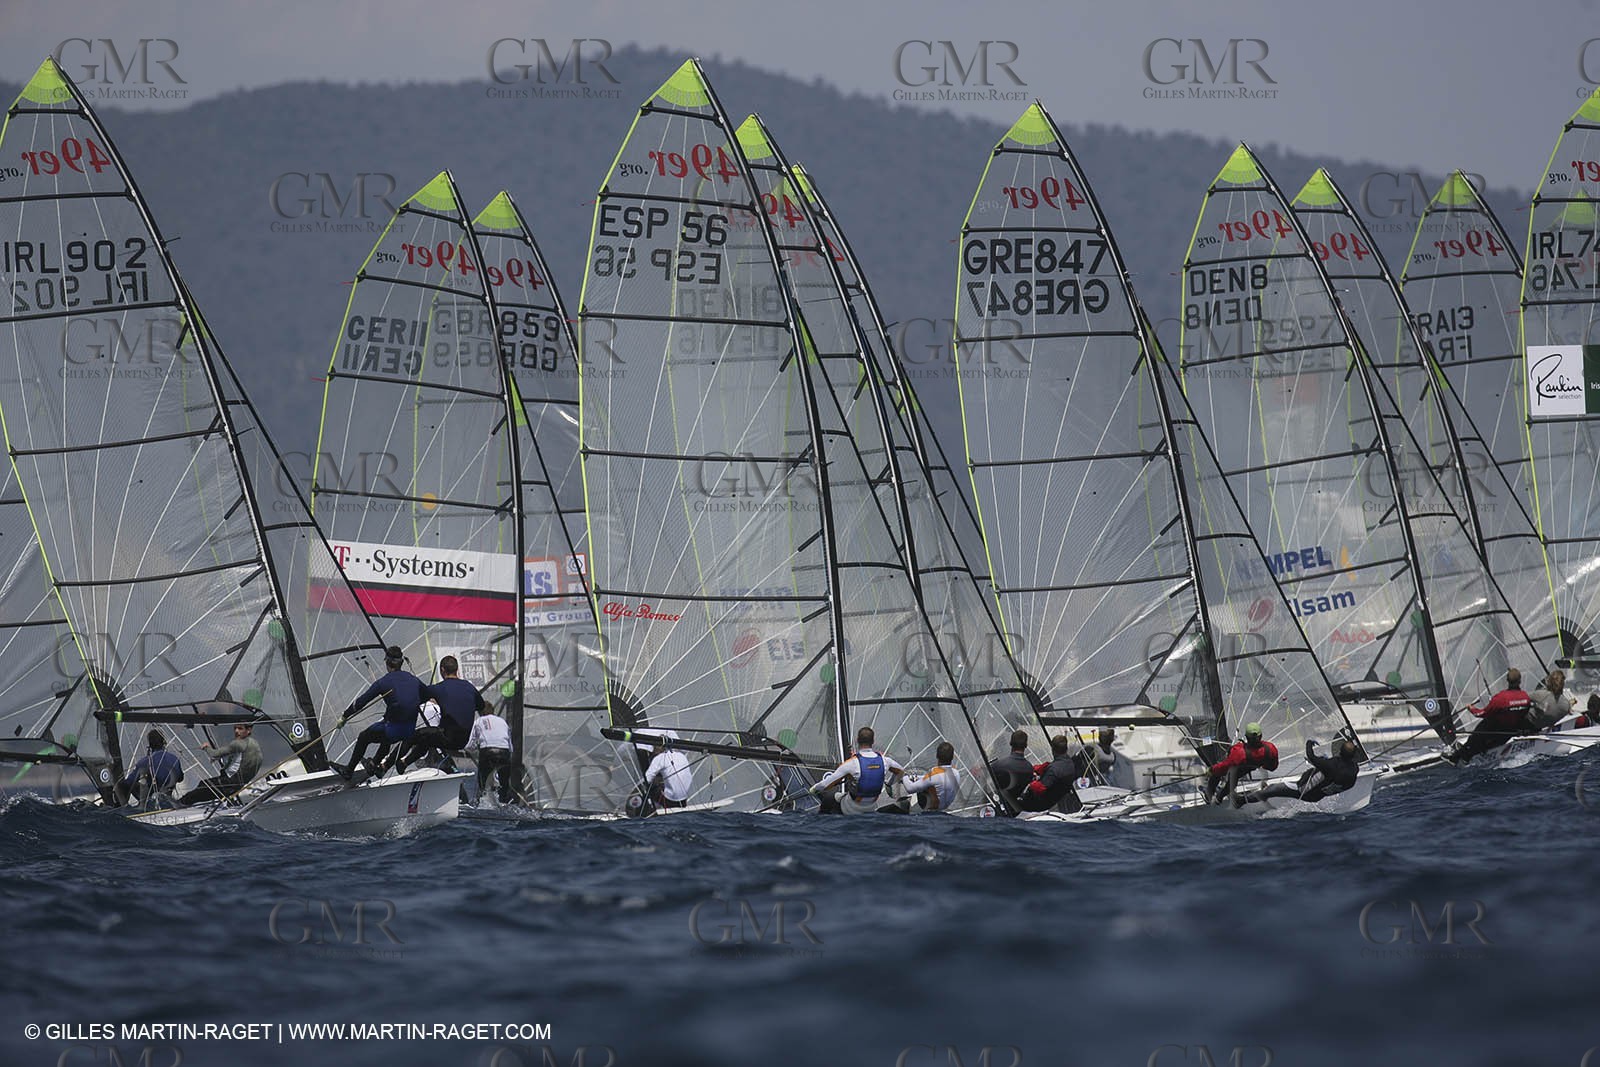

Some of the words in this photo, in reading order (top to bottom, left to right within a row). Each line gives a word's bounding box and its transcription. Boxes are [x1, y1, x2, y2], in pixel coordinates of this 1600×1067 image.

[600, 204, 669, 240] ESP
[680, 211, 729, 247] 56
[963, 238, 1108, 275] GRE847
[602, 601, 633, 622] Alfa
[635, 603, 684, 623] Romeo
